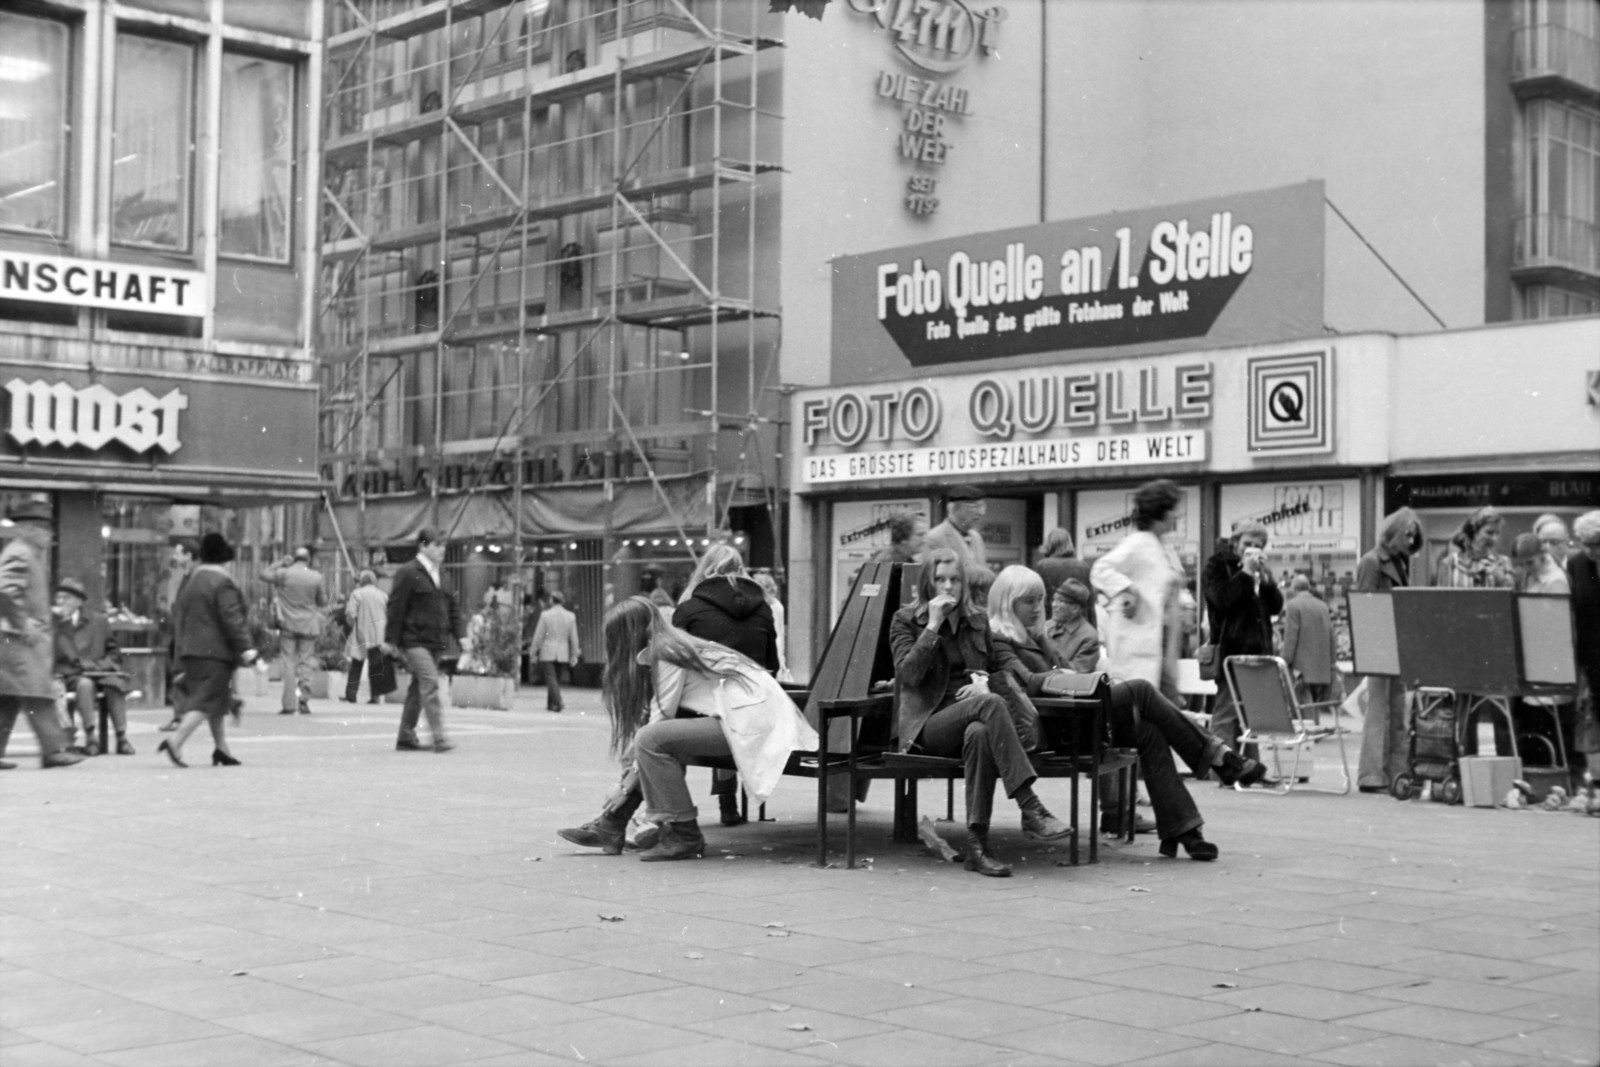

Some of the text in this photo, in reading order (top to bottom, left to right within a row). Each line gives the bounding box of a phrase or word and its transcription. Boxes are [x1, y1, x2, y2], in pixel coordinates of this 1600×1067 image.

[891, 0, 965, 55] 4711
[879, 70, 974, 116] DIE ZAH
[907, 108, 947, 138] DER
[4, 259, 190, 306] NSCHAFT
[877, 211, 1253, 321] Foto Quelle an 1. Stelle
[926, 321, 951, 340] Foto
[996, 312, 1016, 333] das
[1068, 300, 1124, 324] Fotohaus
[1132, 295, 1154, 317] der
[1159, 289, 1189, 314] Welt
[802, 362, 1210, 447] FOTO QUELLE
[810, 435, 1194, 479] DAS GRÖSSTE FOTOSPEZIALHAUS DER WELT
[1549, 480, 1591, 498] BLAU
